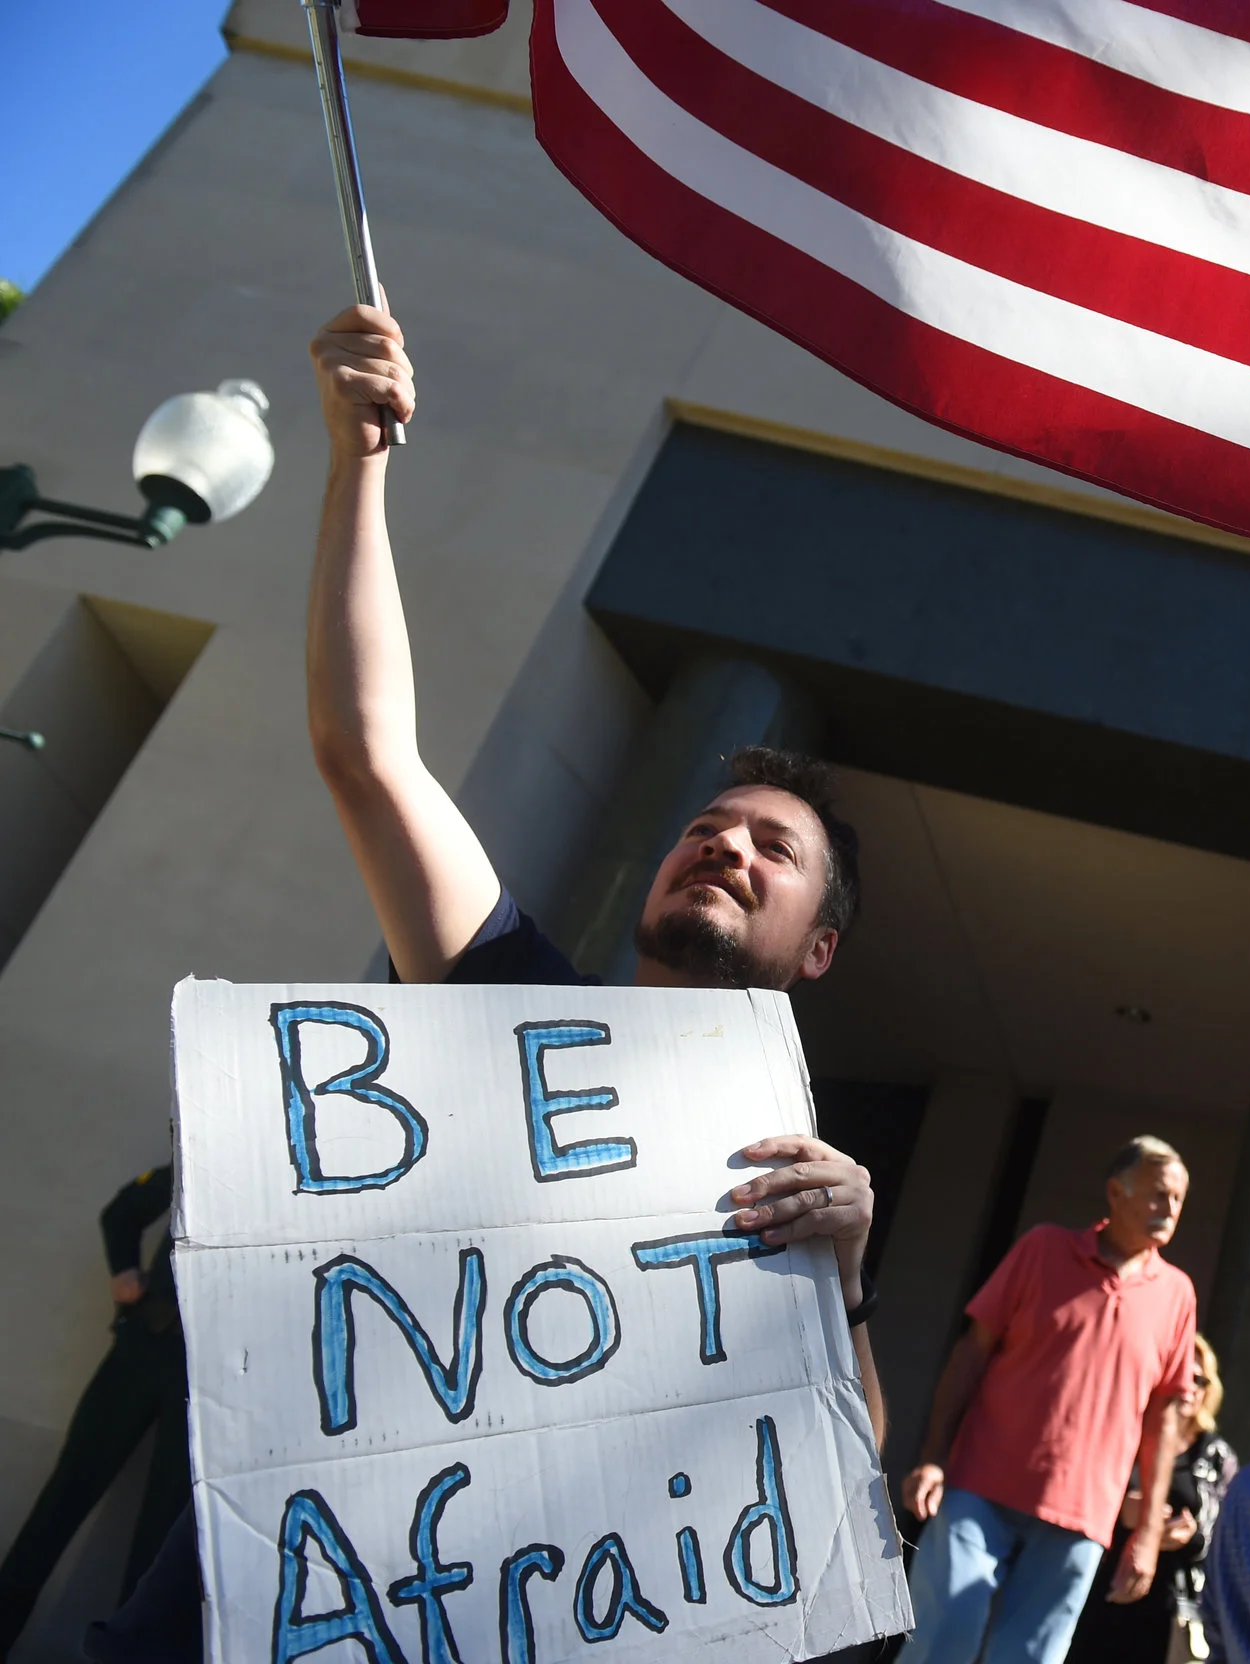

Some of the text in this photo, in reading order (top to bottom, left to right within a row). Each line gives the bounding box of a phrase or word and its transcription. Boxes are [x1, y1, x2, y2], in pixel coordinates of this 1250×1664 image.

[271, 1001, 637, 1195] BE
[311, 1230, 787, 1436] NOT
[270, 1414, 800, 1663] Afraid
